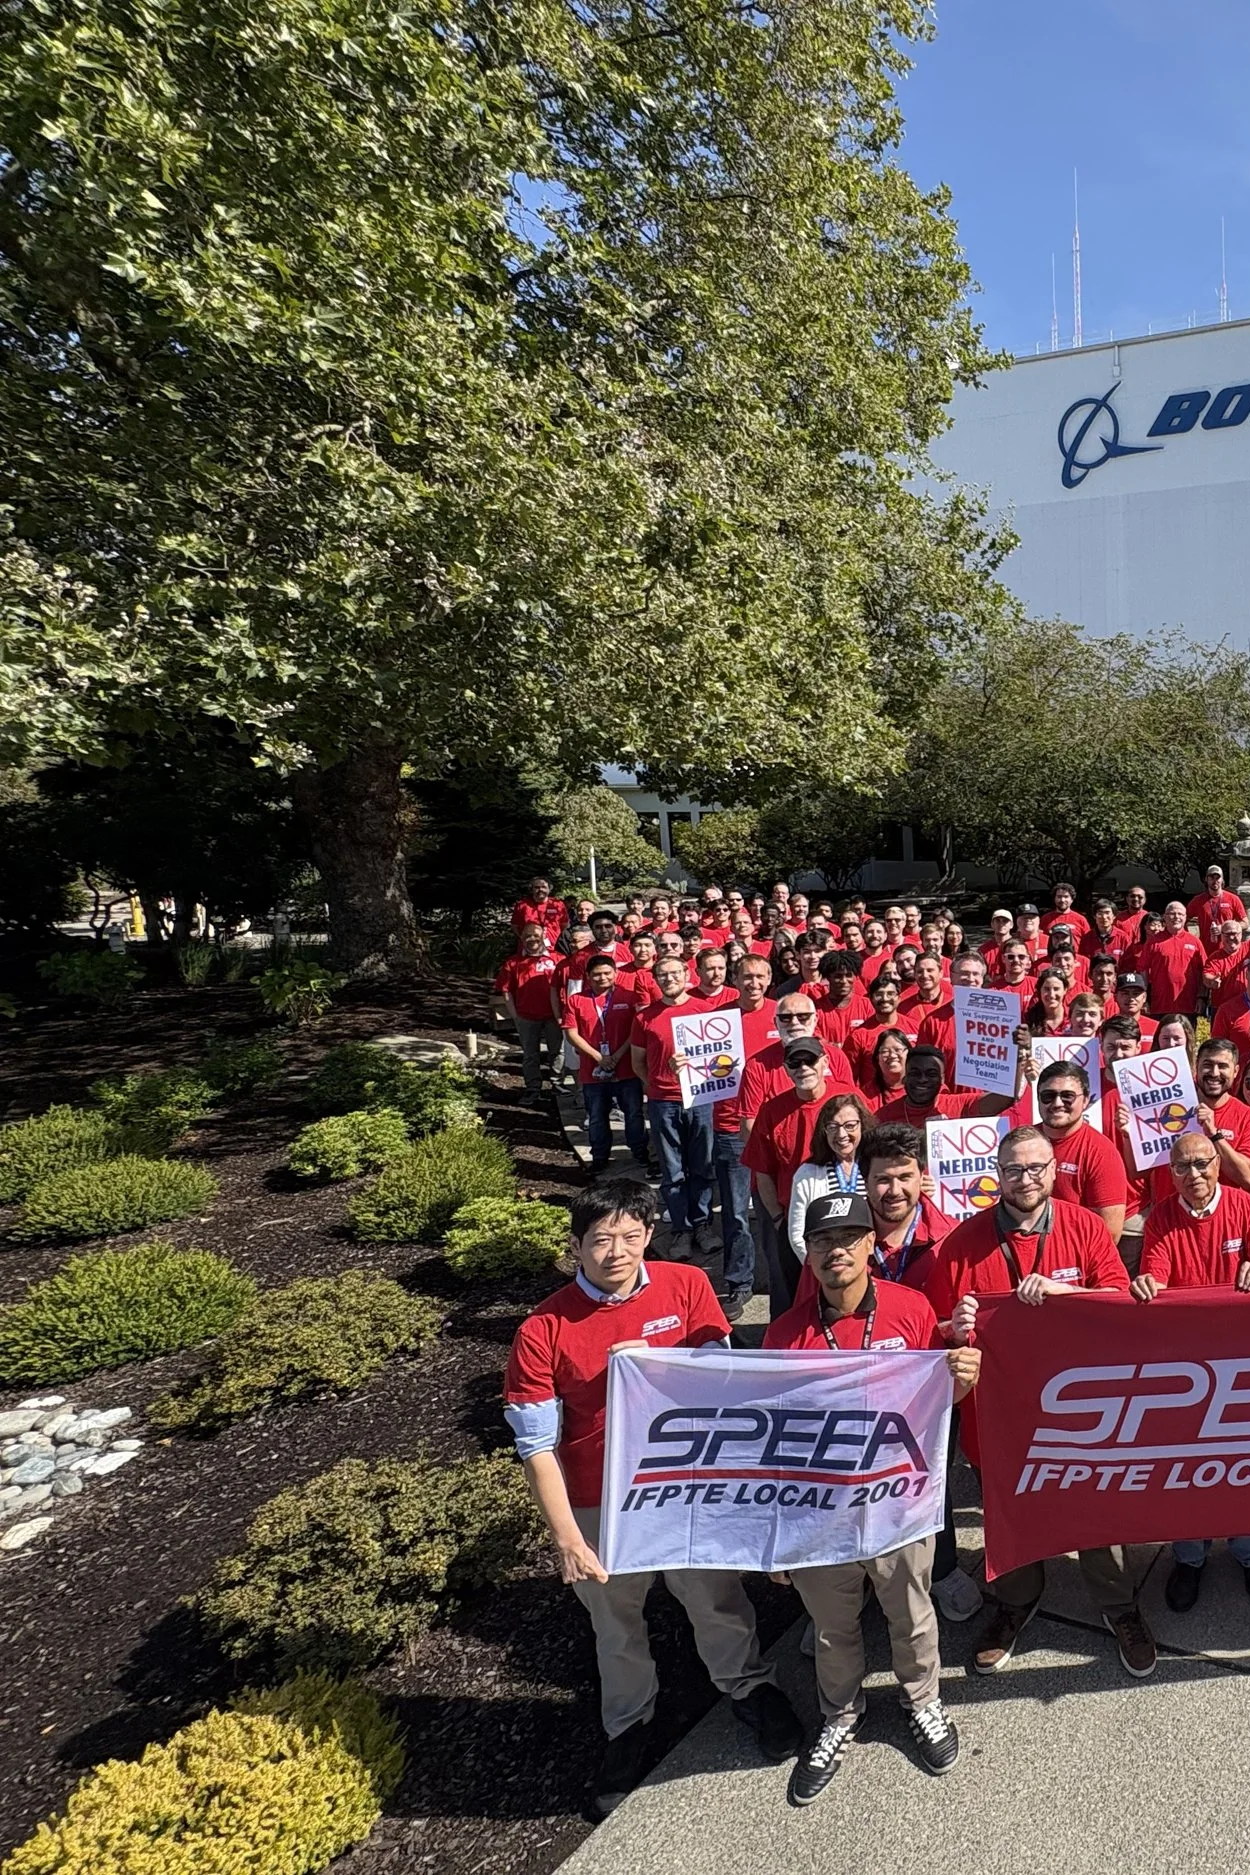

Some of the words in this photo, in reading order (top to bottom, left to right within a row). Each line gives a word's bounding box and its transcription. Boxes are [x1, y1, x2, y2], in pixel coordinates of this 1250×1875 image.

[968, 993, 1007, 1007] SPEEA
[974, 1012, 1000, 1022] Support
[685, 1017, 731, 1042] NO
[966, 1020, 1009, 1038] PROF
[684, 1040, 732, 1057] NERDS
[967, 1041, 1008, 1061] TECH
[963, 1056, 1010, 1072] Negotiation
[975, 1068, 998, 1079] Team!
[1129, 1057, 1178, 1088] NO
[690, 1076, 737, 1096] BIRDS
[1130, 1084, 1183, 1108] NERDS
[943, 1125, 998, 1156] NO
[1141, 1131, 1191, 1156] BIR
[939, 1156, 998, 1175] NERDS
[643, 1315, 681, 1332] SPEEA
[638, 1407, 930, 1472] SPEEA
[1014, 1463, 1155, 1496] IFPTE
[620, 1483, 728, 1512] IFPTE
[733, 1482, 836, 1511] LOCAL
[848, 1475, 930, 1508] 2001
